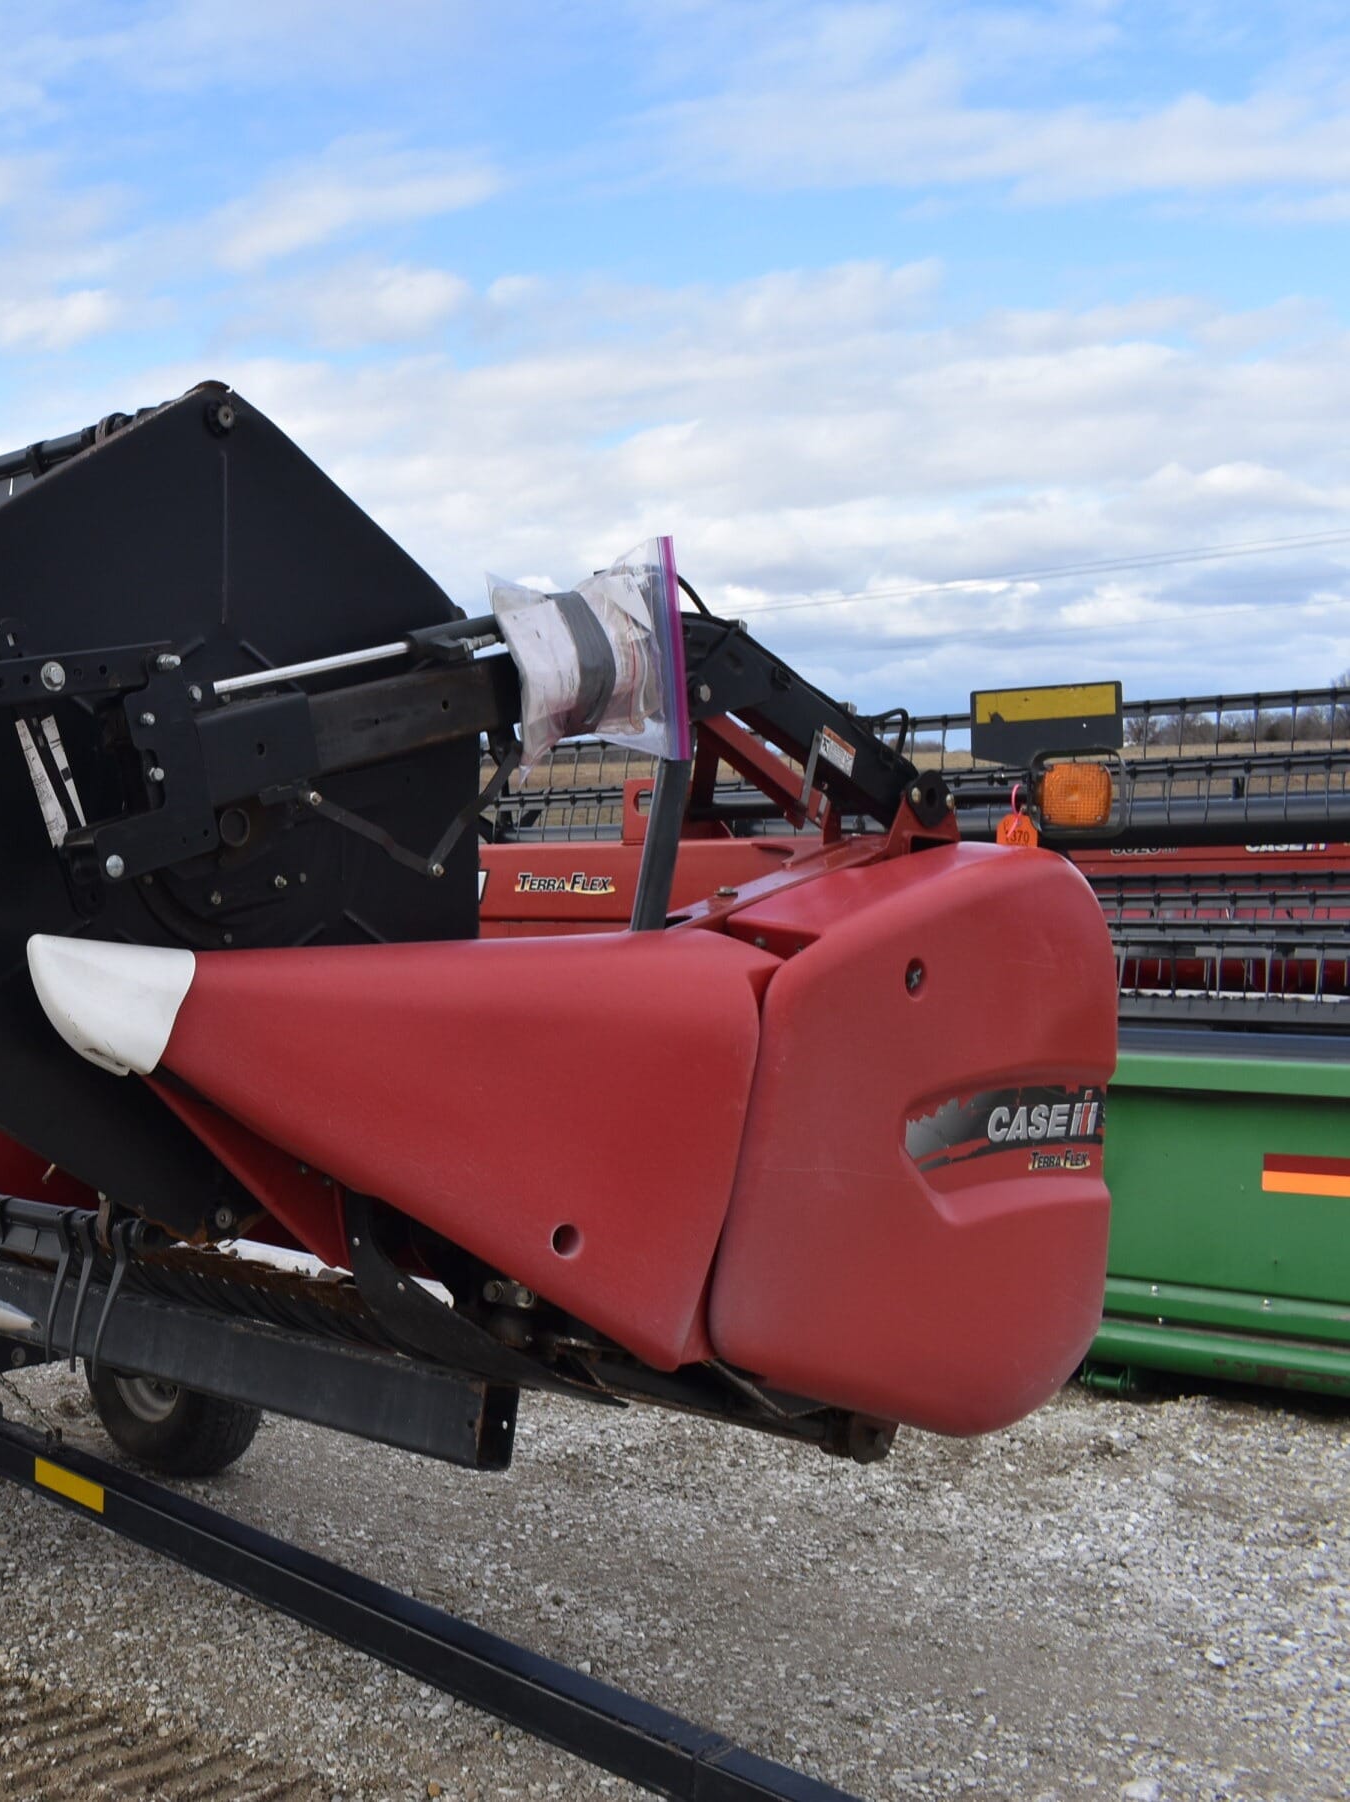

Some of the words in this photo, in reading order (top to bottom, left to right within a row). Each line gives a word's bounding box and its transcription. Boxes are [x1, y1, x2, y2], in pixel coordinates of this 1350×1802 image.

[518, 872, 566, 892] TERRA
[569, 872, 612, 892] FLEX
[987, 1103, 1070, 1143] CASE
[1030, 1150, 1061, 1169] TERRA
[1063, 1148, 1089, 1168] FLEX
